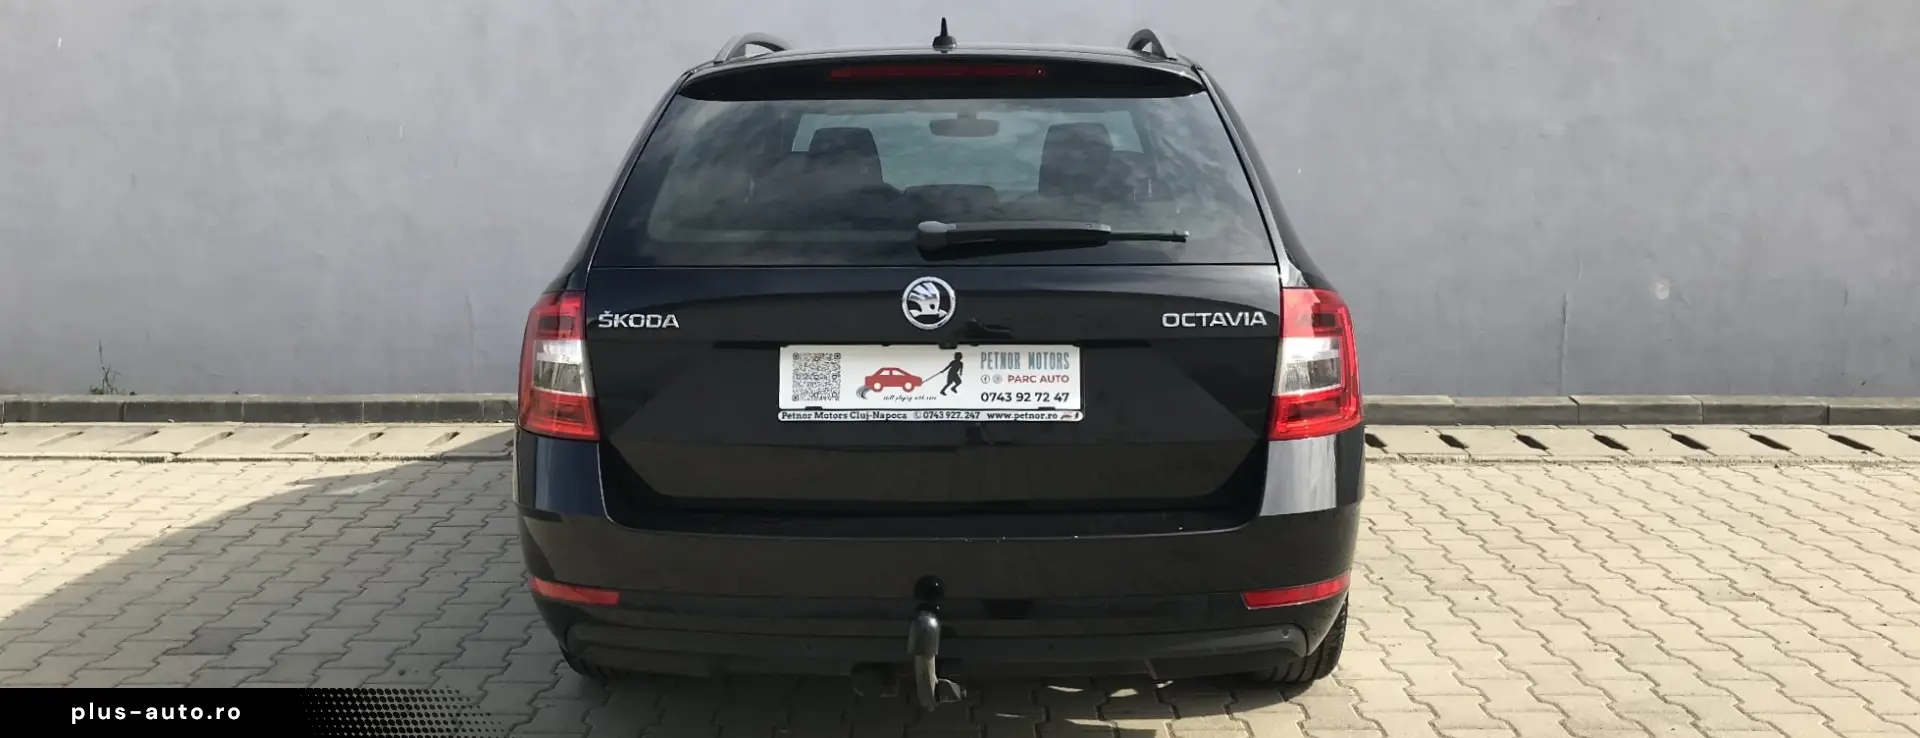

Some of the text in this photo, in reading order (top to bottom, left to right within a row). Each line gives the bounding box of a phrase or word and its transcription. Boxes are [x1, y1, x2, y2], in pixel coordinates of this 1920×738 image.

[598, 310, 680, 328] ŠKODA
[1162, 311, 1268, 327] OCTAVIA
[980, 351, 1070, 370] PETNOR MOTORS
[1007, 374, 1070, 383] PARC AUTO
[980, 391, 1070, 402] 0743 92 72 47
[780, 411, 908, 421] Petnor Motors Cluj-Napoca
[922, 411, 944, 419] 0743
[964, 411, 981, 419] 247
[986, 411, 1058, 421] www.petnor.ro
